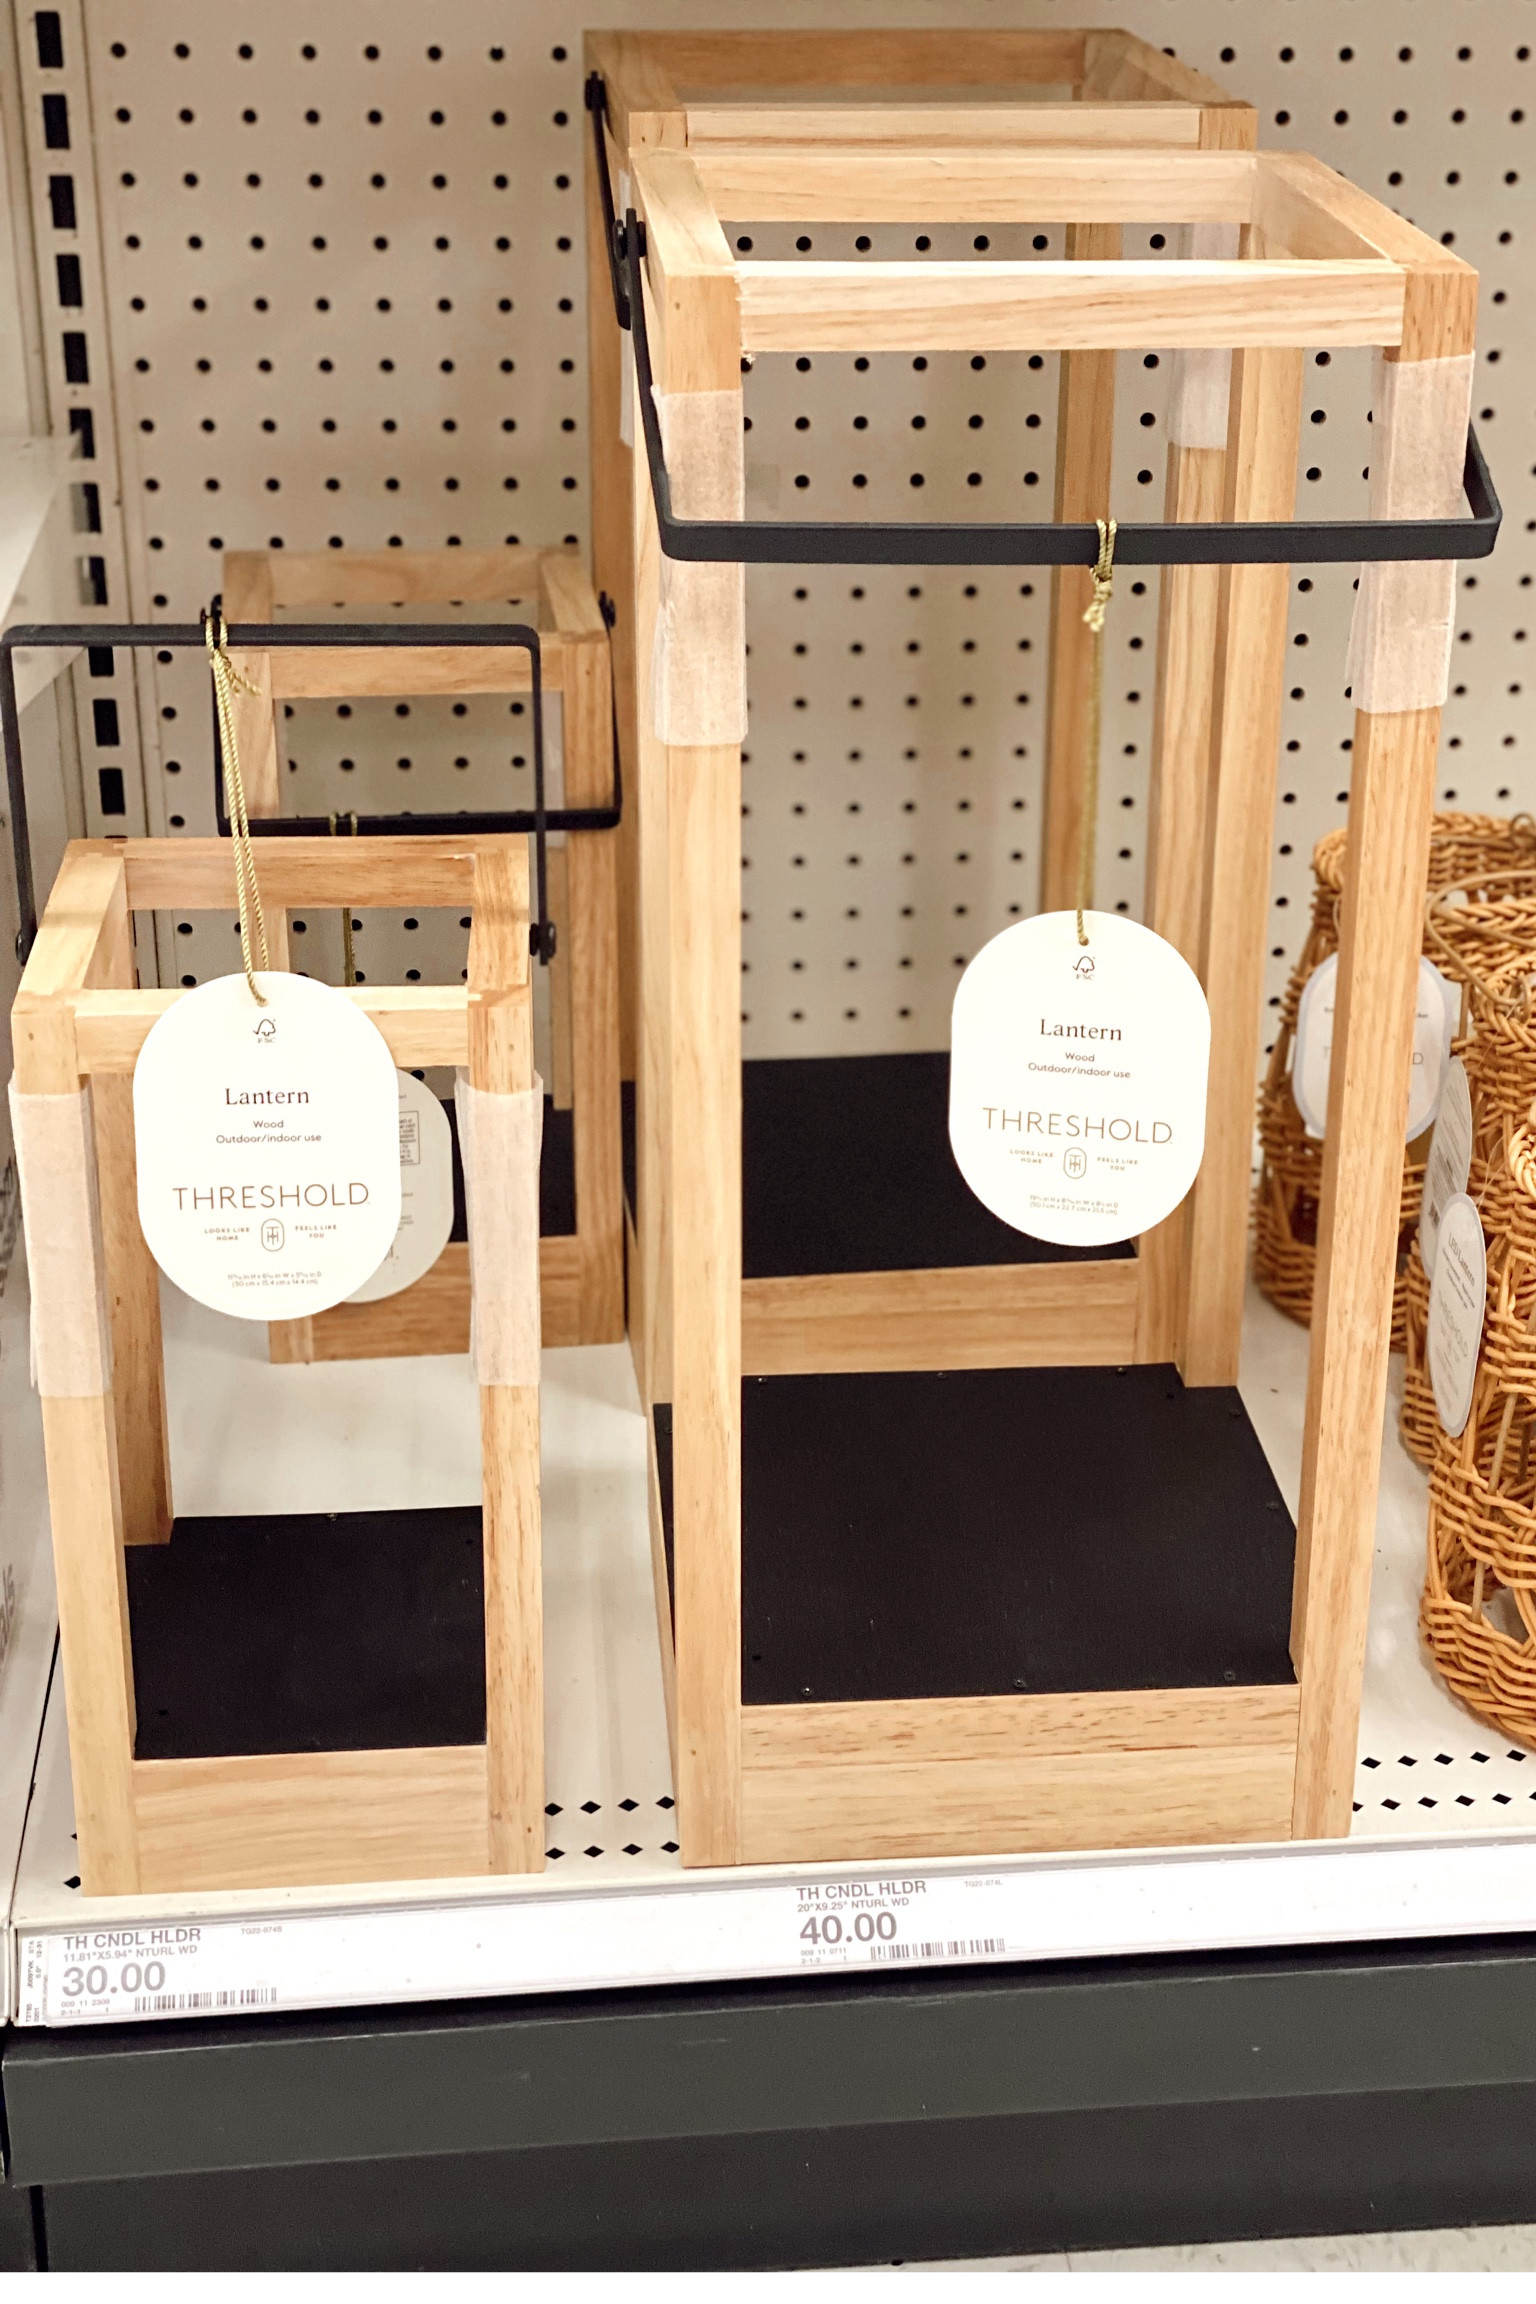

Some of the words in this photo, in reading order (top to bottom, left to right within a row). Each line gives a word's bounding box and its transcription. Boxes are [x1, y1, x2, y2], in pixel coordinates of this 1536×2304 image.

[1039, 1018, 1122, 1041] Lantern
[1065, 1052, 1095, 1062] Wood
[1028, 1062, 1111, 1078] Outdoor/indoor
[1113, 1070, 1131, 1079] use
[224, 1087, 310, 1105] Lantern
[253, 1119, 284, 1129] Wood
[982, 1107, 1173, 1144] THRESHOLD
[216, 1133, 301, 1144] Outdoor/indoor
[304, 1134, 322, 1142] use
[172, 1182, 369, 1211] THRESHOLD
[797, 1887, 819, 1900] TH
[825, 1884, 874, 1899] CNDL
[879, 1880, 927, 1895] HLDR
[851, 1898, 888, 1909] NTURL
[891, 1897, 910, 1906] WD
[800, 1911, 897, 1945] 40.00
[64, 1936, 87, 1950] TH
[94, 1932, 145, 1948] CNDL
[151, 1928, 201, 1944] HLDR
[64, 1949, 132, 1962] 11.81"X5.94"
[136, 1946, 174, 1957] NTURL
[178, 1944, 198, 1954] WD
[62, 1961, 166, 1997] 30.00
